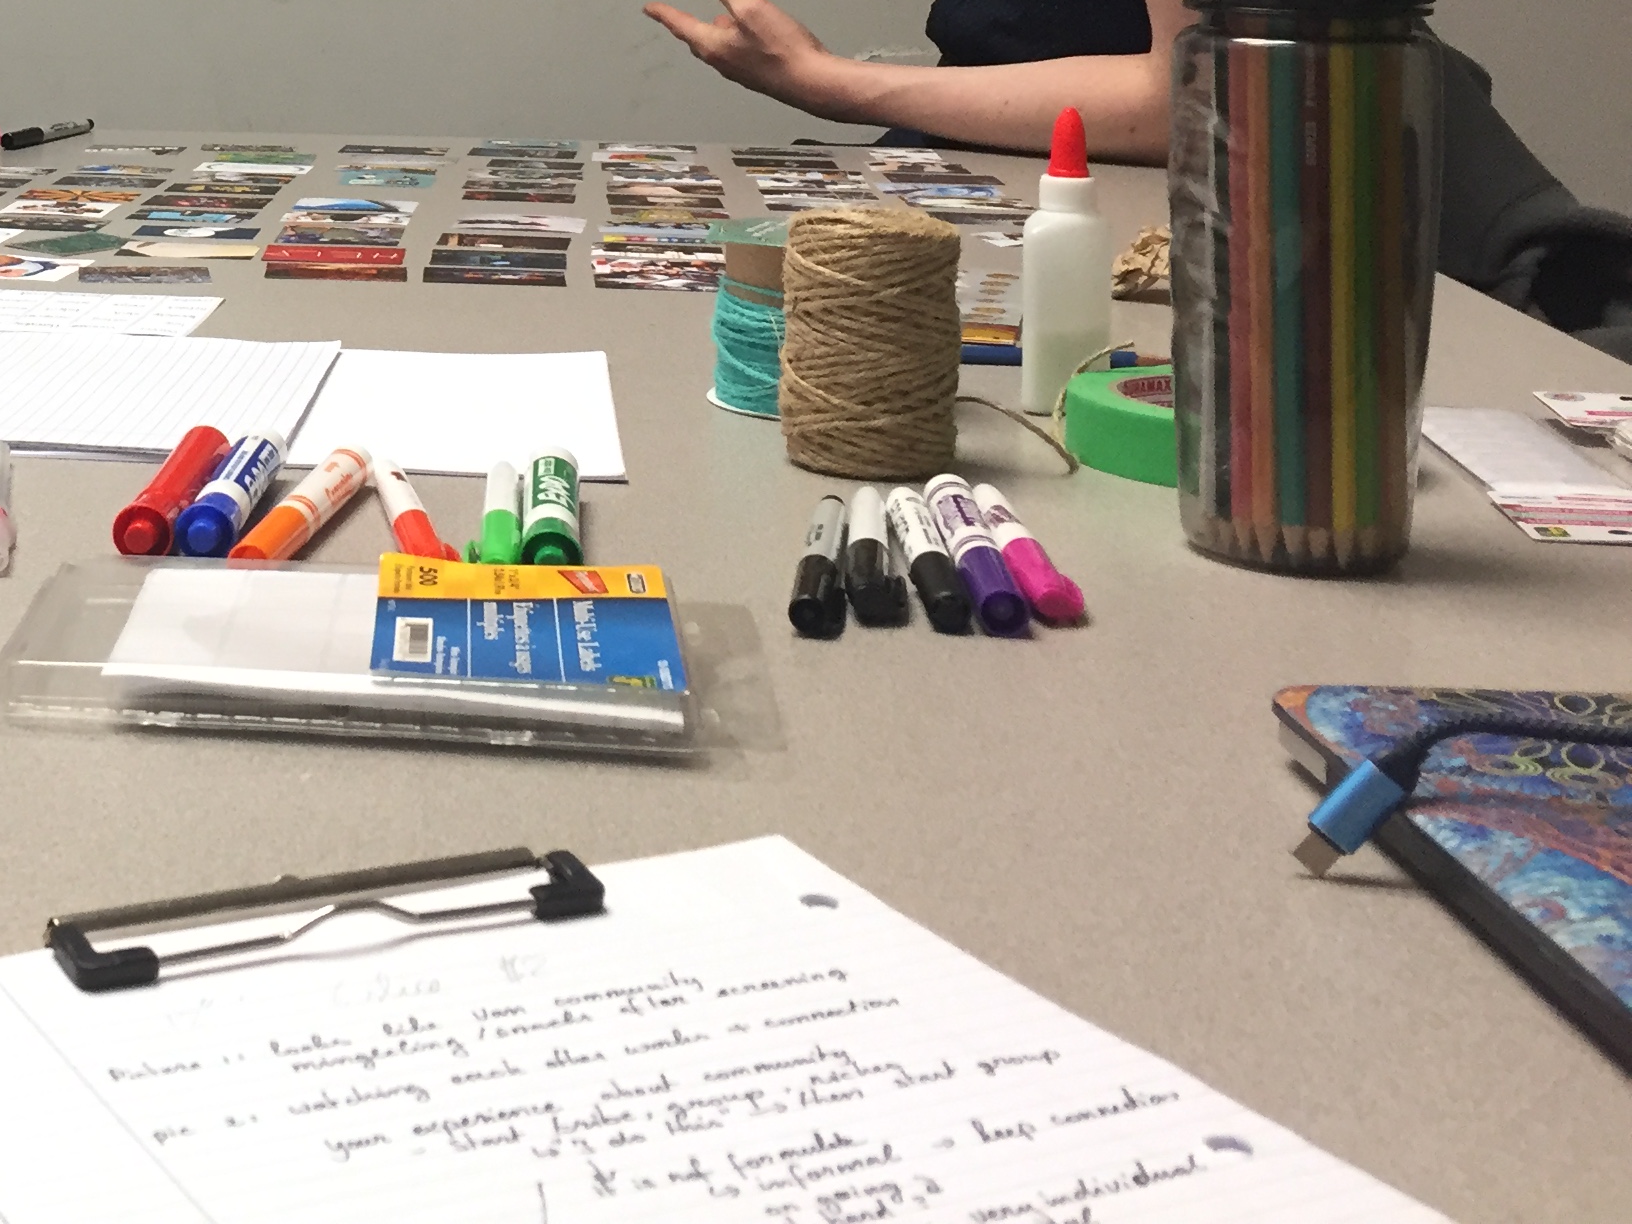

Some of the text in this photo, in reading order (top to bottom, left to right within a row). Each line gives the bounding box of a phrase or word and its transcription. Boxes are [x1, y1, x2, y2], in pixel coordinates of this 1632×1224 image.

[419, 565, 439, 587] 500
[554, 970, 704, 1007] community
[289, 1085, 431, 1116] watching
[764, 998, 900, 1028] connection
[600, 1071, 676, 1101] about
